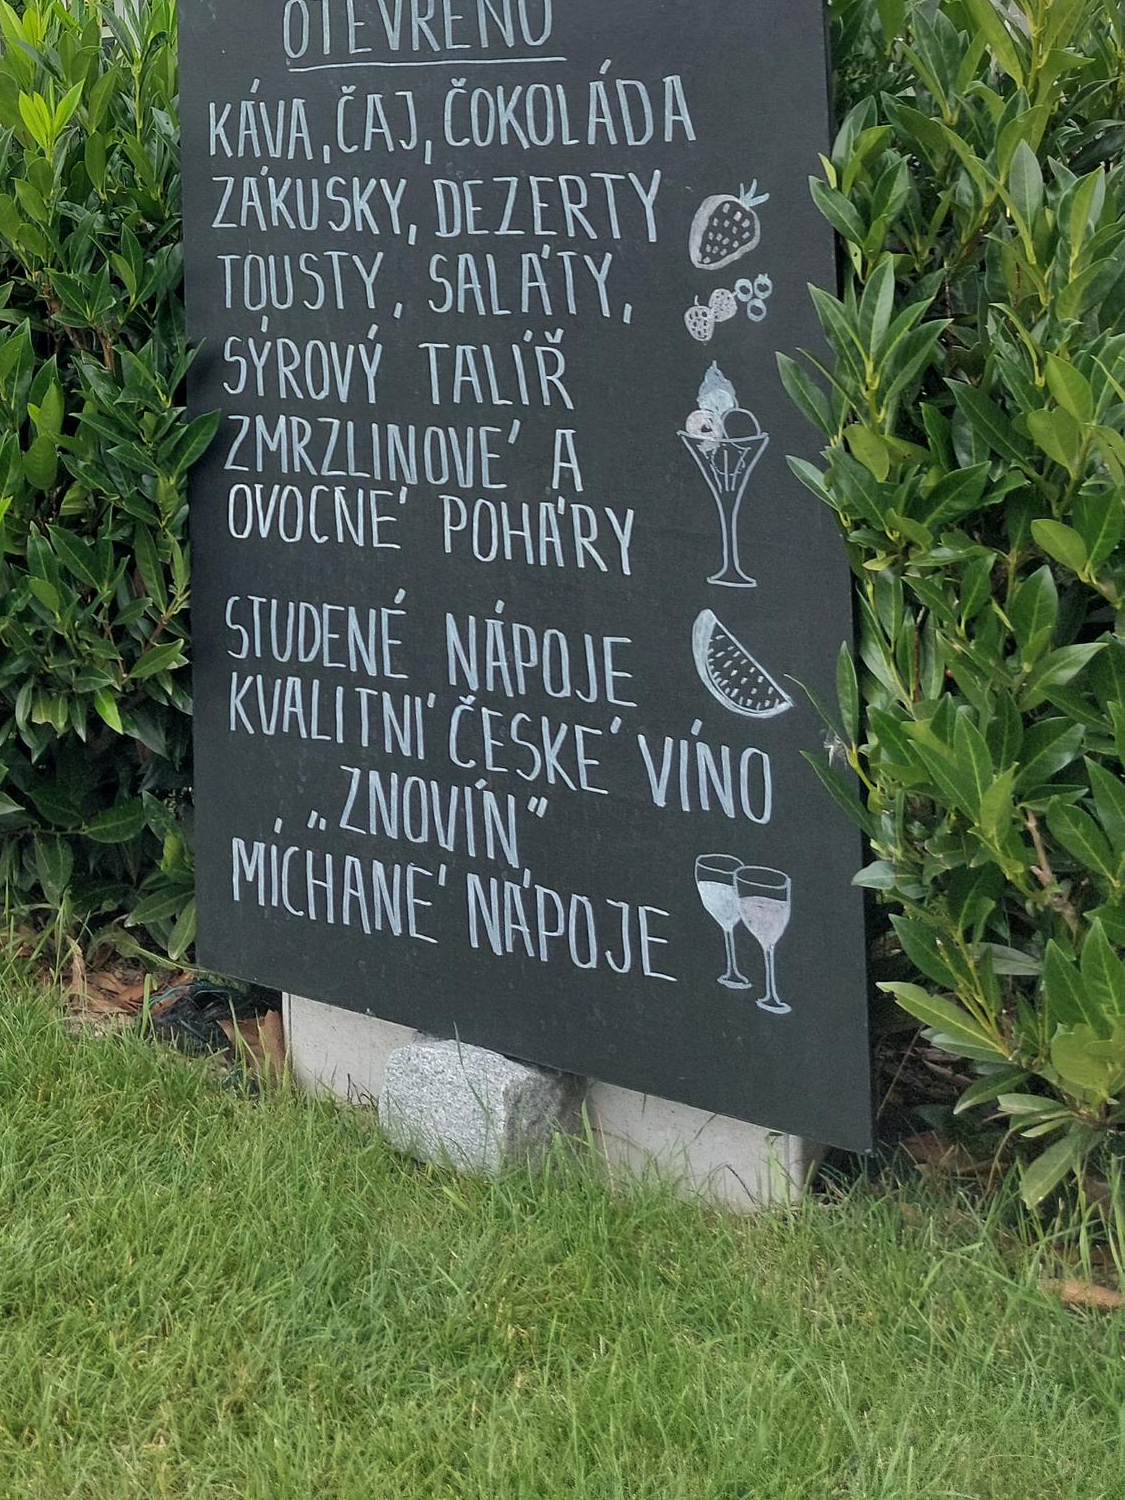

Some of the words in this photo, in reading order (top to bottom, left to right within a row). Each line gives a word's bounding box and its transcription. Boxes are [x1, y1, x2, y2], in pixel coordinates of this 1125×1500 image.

[208, 78, 331, 165] KÁVA,
[336, 85, 433, 165] ČAJ,
[443, 58, 697, 150] ČOKOLÁDA
[210, 165, 418, 246] ZÁKUSKY,
[433, 168, 662, 244] DEZERTY
[427, 243, 633, 325] SALÁTY,
[222, 314, 384, 405] SÝROVÝ
[418, 327, 575, 411] TALÍŘ
[223, 414, 521, 490] ZMRZLINOVÉ
[552, 428, 584, 492] A
[227, 482, 408, 550] OVOCNÉ
[437, 493, 635, 577] POHÁRY
[225, 588, 408, 680] STUDENÉ
[446, 599, 638, 707] NÁPOJE
[229, 671, 435, 761] KVALITNÍ
[449, 694, 622, 795] ČESKÉ
[637, 718, 773, 825] VÍNO
[231, 816, 447, 944] MÍCHANÉ
[466, 867, 678, 982] NÁPOJE
